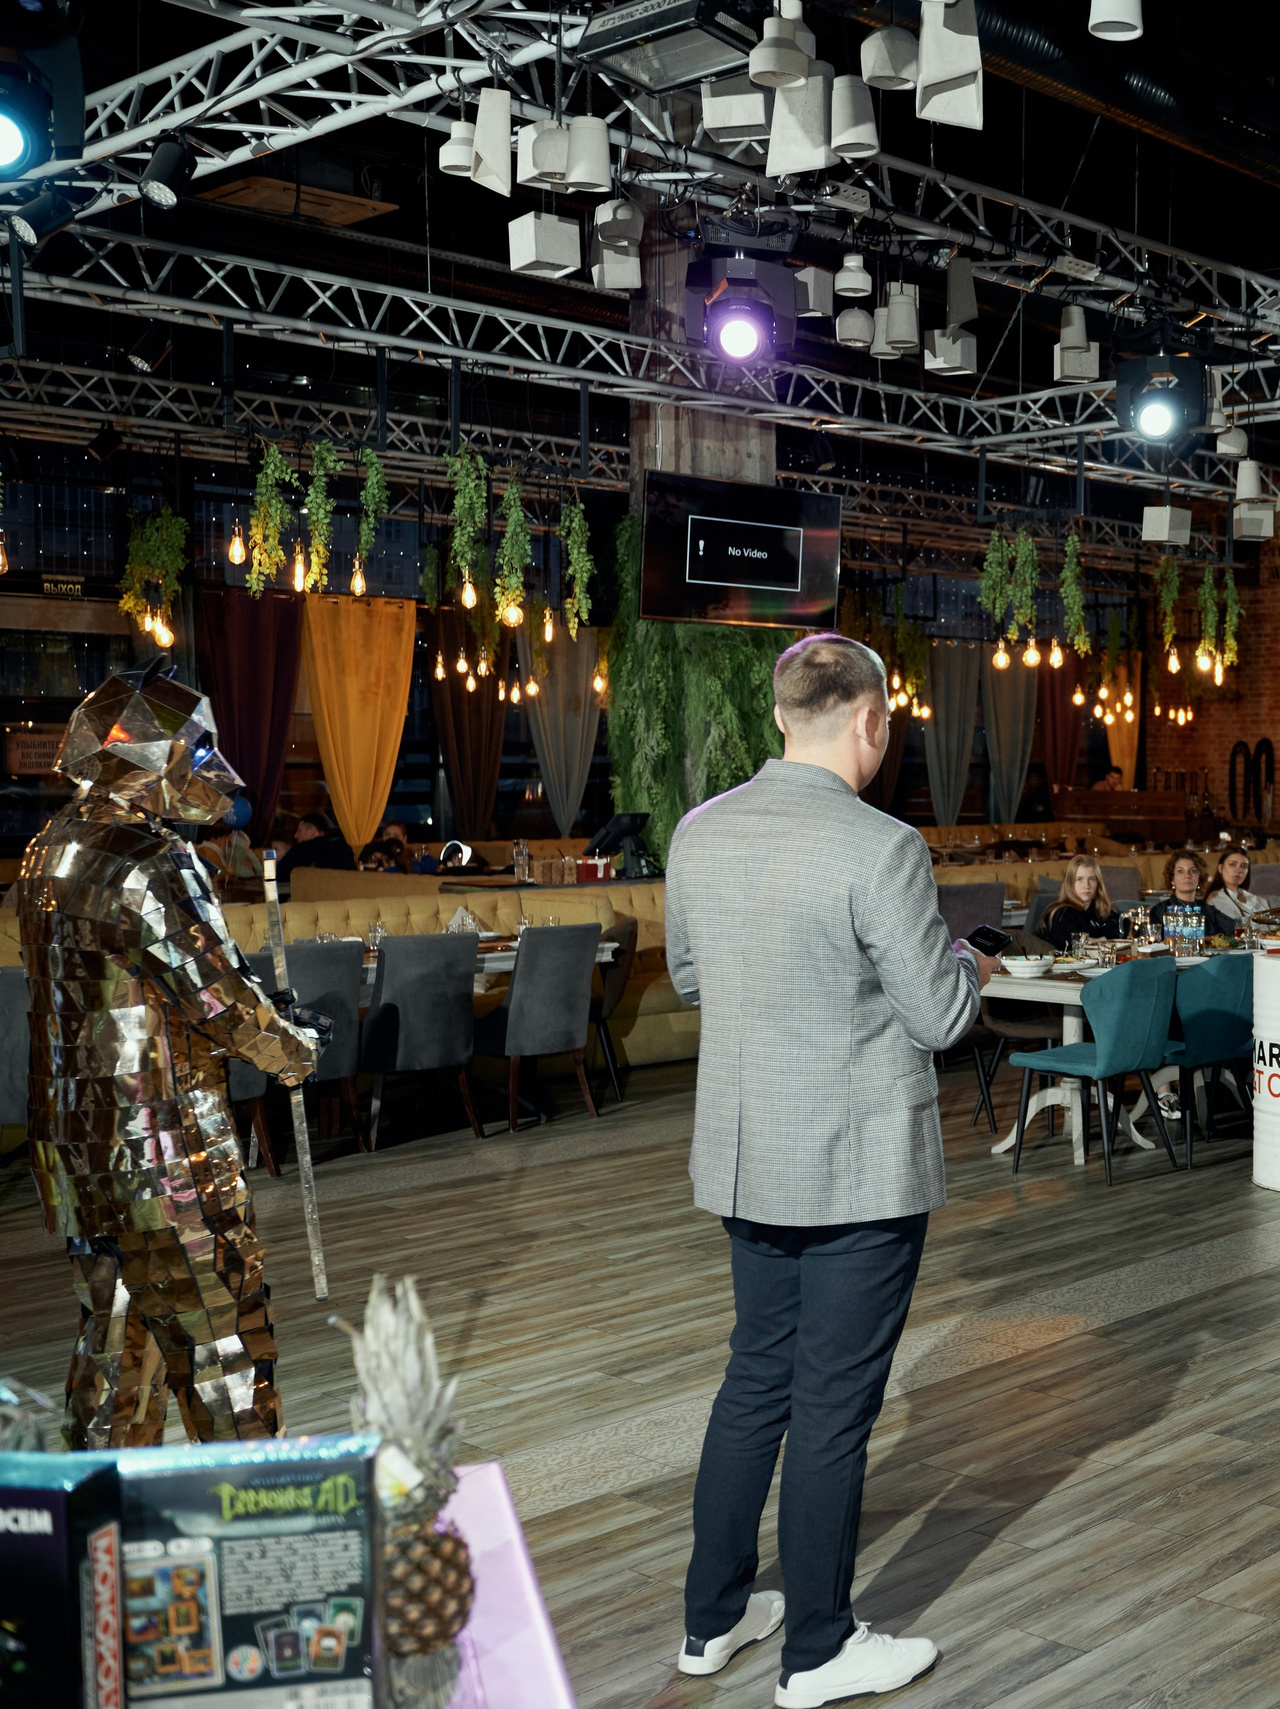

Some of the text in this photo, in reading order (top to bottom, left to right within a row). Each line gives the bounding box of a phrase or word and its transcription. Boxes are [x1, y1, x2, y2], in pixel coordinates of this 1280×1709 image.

[728, 546, 768, 560] No Video
[43, 583, 82, 597] ВЫХОД
[16, 740, 60, 750] УЛЫБНИТЕС
[34, 751, 56, 759] СНИМА
